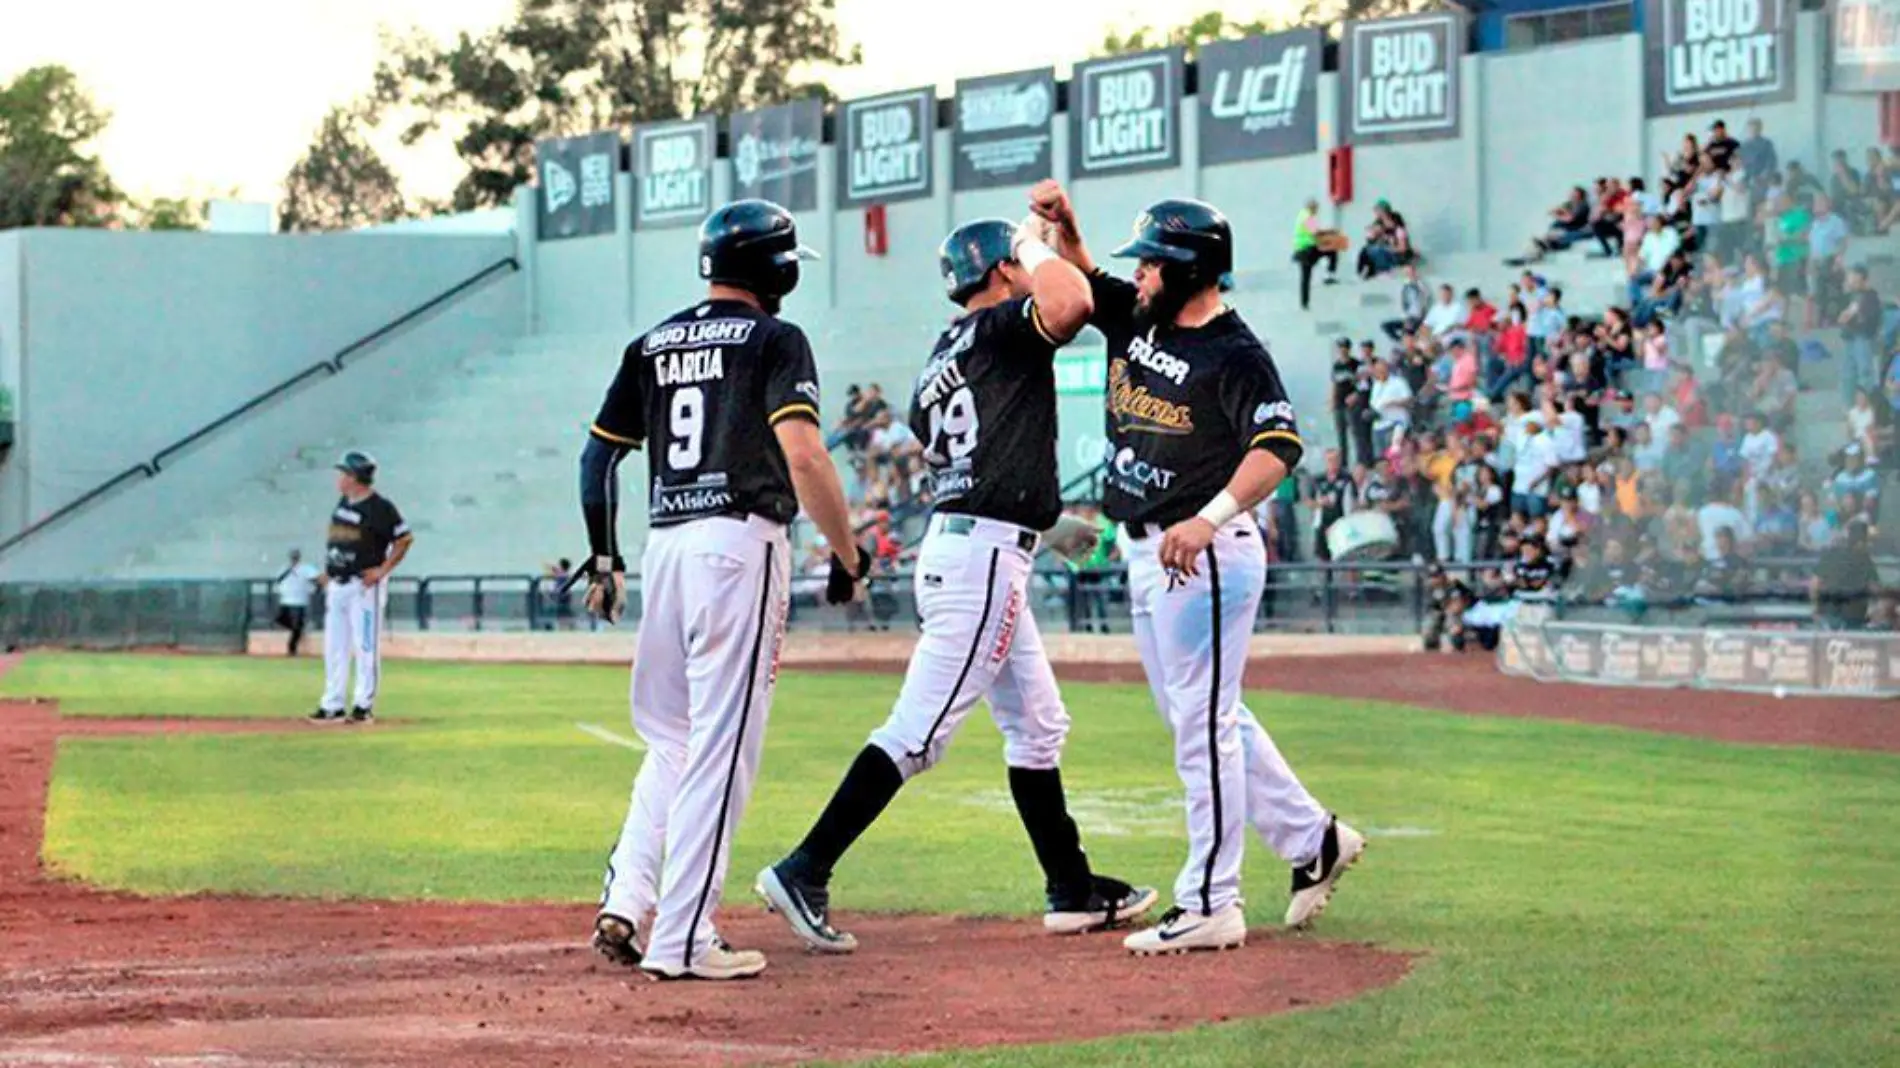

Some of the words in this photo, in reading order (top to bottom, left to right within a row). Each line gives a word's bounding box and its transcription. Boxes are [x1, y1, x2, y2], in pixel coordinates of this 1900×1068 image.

[1686, 0, 1758, 40] BUD
[1371, 32, 1435, 76] BUD
[1673, 34, 1773, 88] LIGHT
[1098, 70, 1154, 115] BUD
[1211, 45, 1307, 118] udi
[1360, 71, 1446, 120] LIGHT
[861, 104, 912, 148] BUD
[1089, 109, 1163, 156] LIGHT
[651, 136, 696, 174] BUD
[854, 142, 921, 186] LIGHT
[644, 170, 703, 210] LIGHT
[649, 327, 685, 348] BUD
[688, 322, 746, 341] LIGHT
[668, 386, 704, 469] 9
[661, 490, 732, 511] Misión
